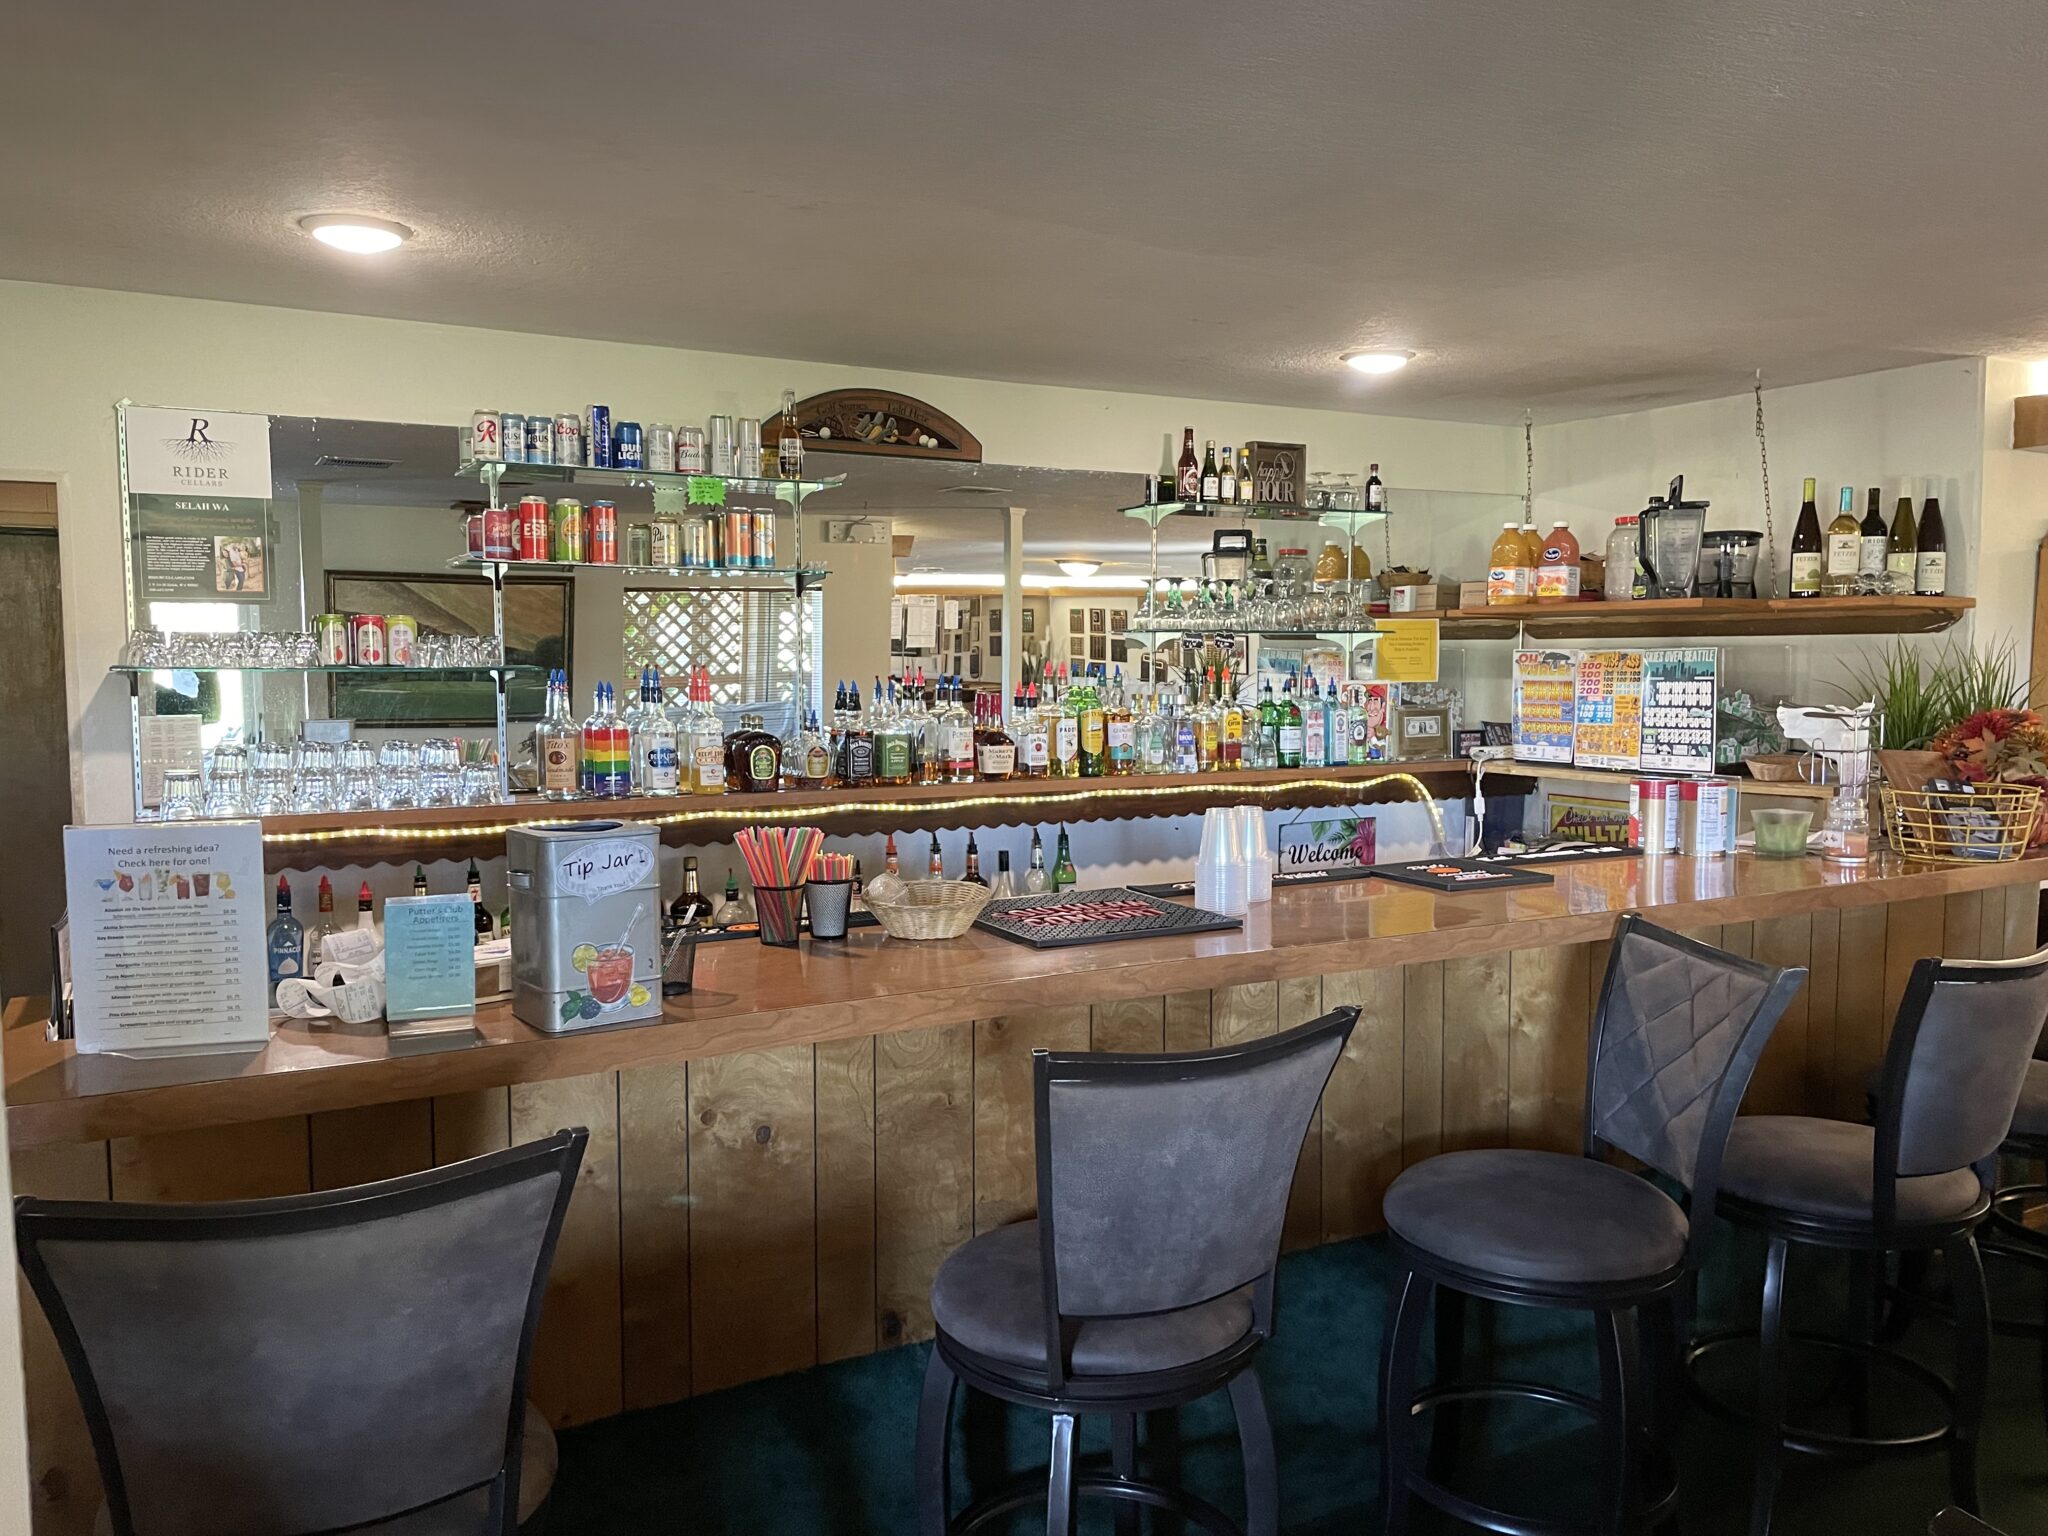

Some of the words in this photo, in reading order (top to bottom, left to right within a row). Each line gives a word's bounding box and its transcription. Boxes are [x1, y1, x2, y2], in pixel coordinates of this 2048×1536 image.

[557, 421, 581, 436] Coo
[532, 432, 549, 443] BUS
[620, 443, 642, 452] BUD
[172, 466, 230, 480] RIDER
[1257, 461, 1286, 482] happy
[180, 479, 223, 488] CELLARS
[1258, 480, 1295, 502] HOUR
[175, 502, 210, 511] SELAH
[212, 503, 230, 512] WA
[1518, 653, 1538, 664] OH
[1665, 651, 1683, 662] OVER
[1684, 650, 1714, 662] SEATTLE
[546, 740, 571, 750] Tito's
[1556, 825, 1630, 842] PULLTA
[108, 847, 133, 856] Need
[144, 845, 193, 855] refreshing
[194, 843, 220, 853] idea?
[1288, 843, 1364, 865] Welcome
[118, 859, 146, 868] Check
[149, 858, 171, 867] here
[173, 857, 188, 866] for
[189, 856, 211, 866] one!
[563, 858, 594, 880] Tip
[602, 854, 634, 870] Jar
[471, 888, 479, 901] 7
[408, 906, 443, 916] Putter's
[444, 905, 464, 914] Club
[412, 915, 460, 925] Appetizers
